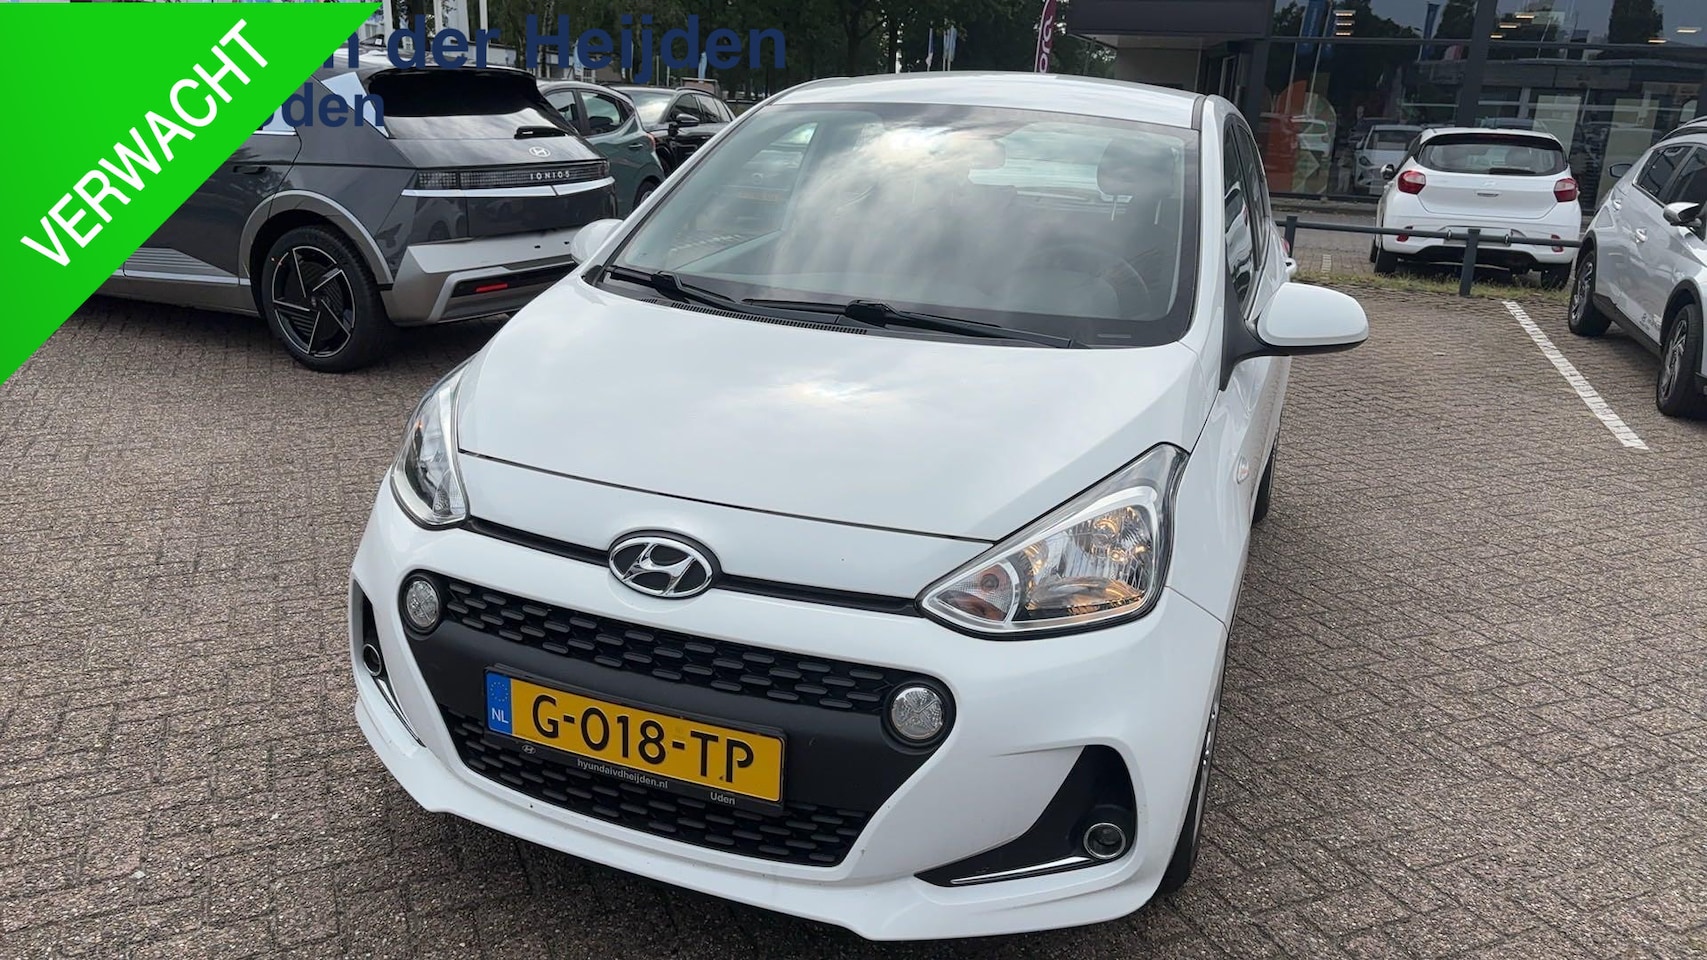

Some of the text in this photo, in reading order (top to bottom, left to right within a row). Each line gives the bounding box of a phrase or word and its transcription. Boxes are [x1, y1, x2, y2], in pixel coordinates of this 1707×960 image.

[491, 707, 510, 725] NL
[532, 694, 754, 784] G-018-TP
[577, 758, 669, 789] hyundaivdheijden.nl
[710, 791, 736, 806] Uden
